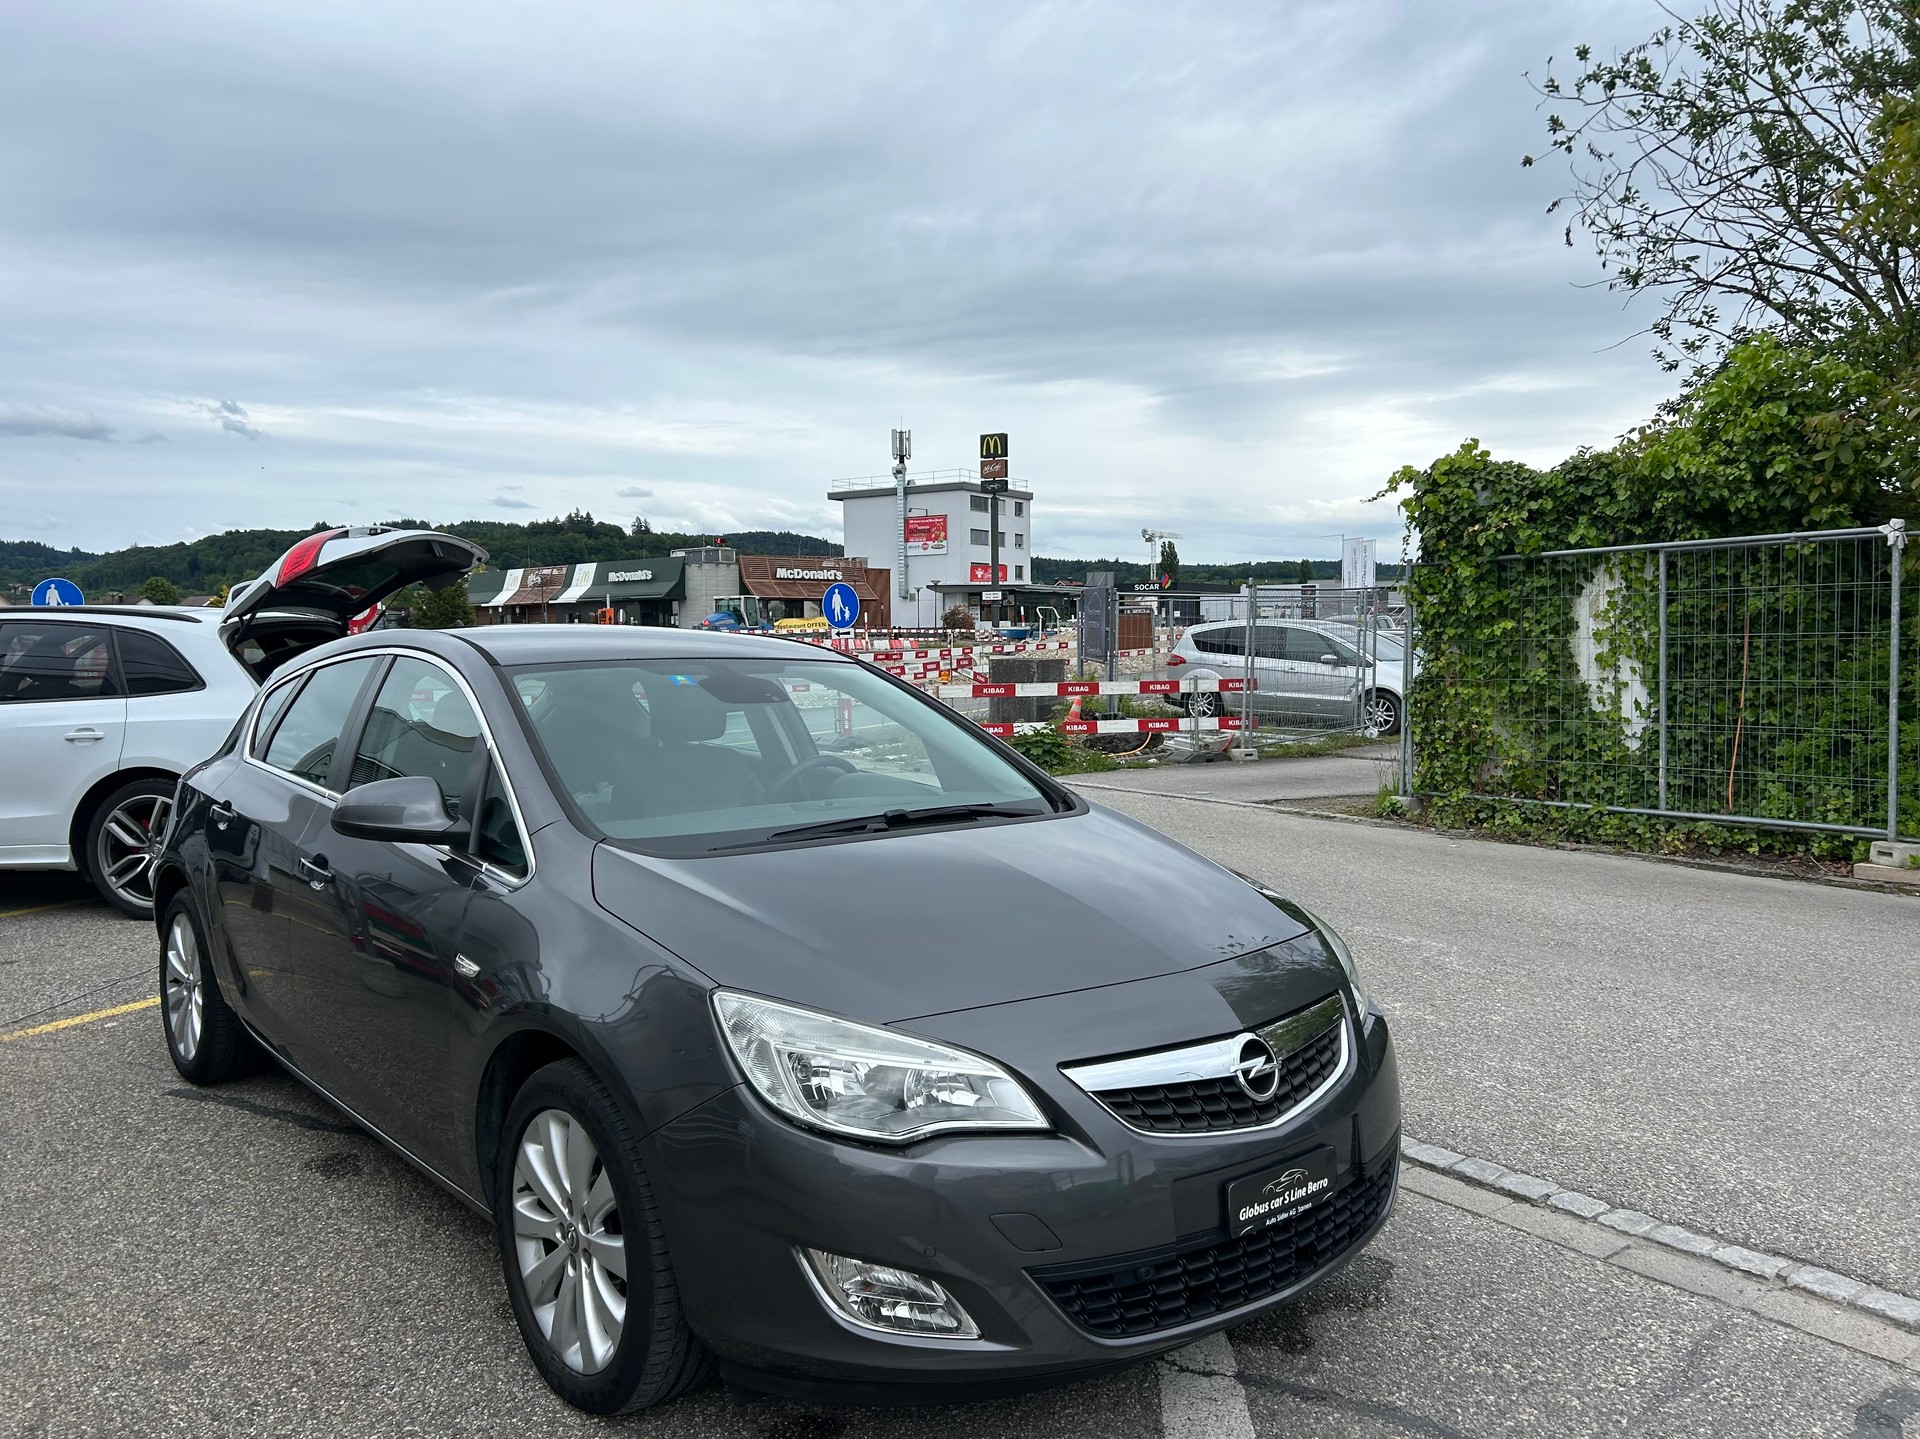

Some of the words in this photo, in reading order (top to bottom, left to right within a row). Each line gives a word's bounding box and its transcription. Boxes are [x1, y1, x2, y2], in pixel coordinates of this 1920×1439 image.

[608, 569, 652, 582] McDonald's
[776, 567, 843, 580] McDonald's
[1134, 583, 1160, 591] SOCAR
[1239, 1202, 1269, 1221] Globus
[1270, 1195, 1284, 1210] car
[1284, 1191, 1290, 1204] S
[1290, 1187, 1307, 1202] Line
[1307, 1177, 1328, 1194] Berro
[1265, 1216, 1277, 1226] Auto
[1289, 1208, 1296, 1217] AG
